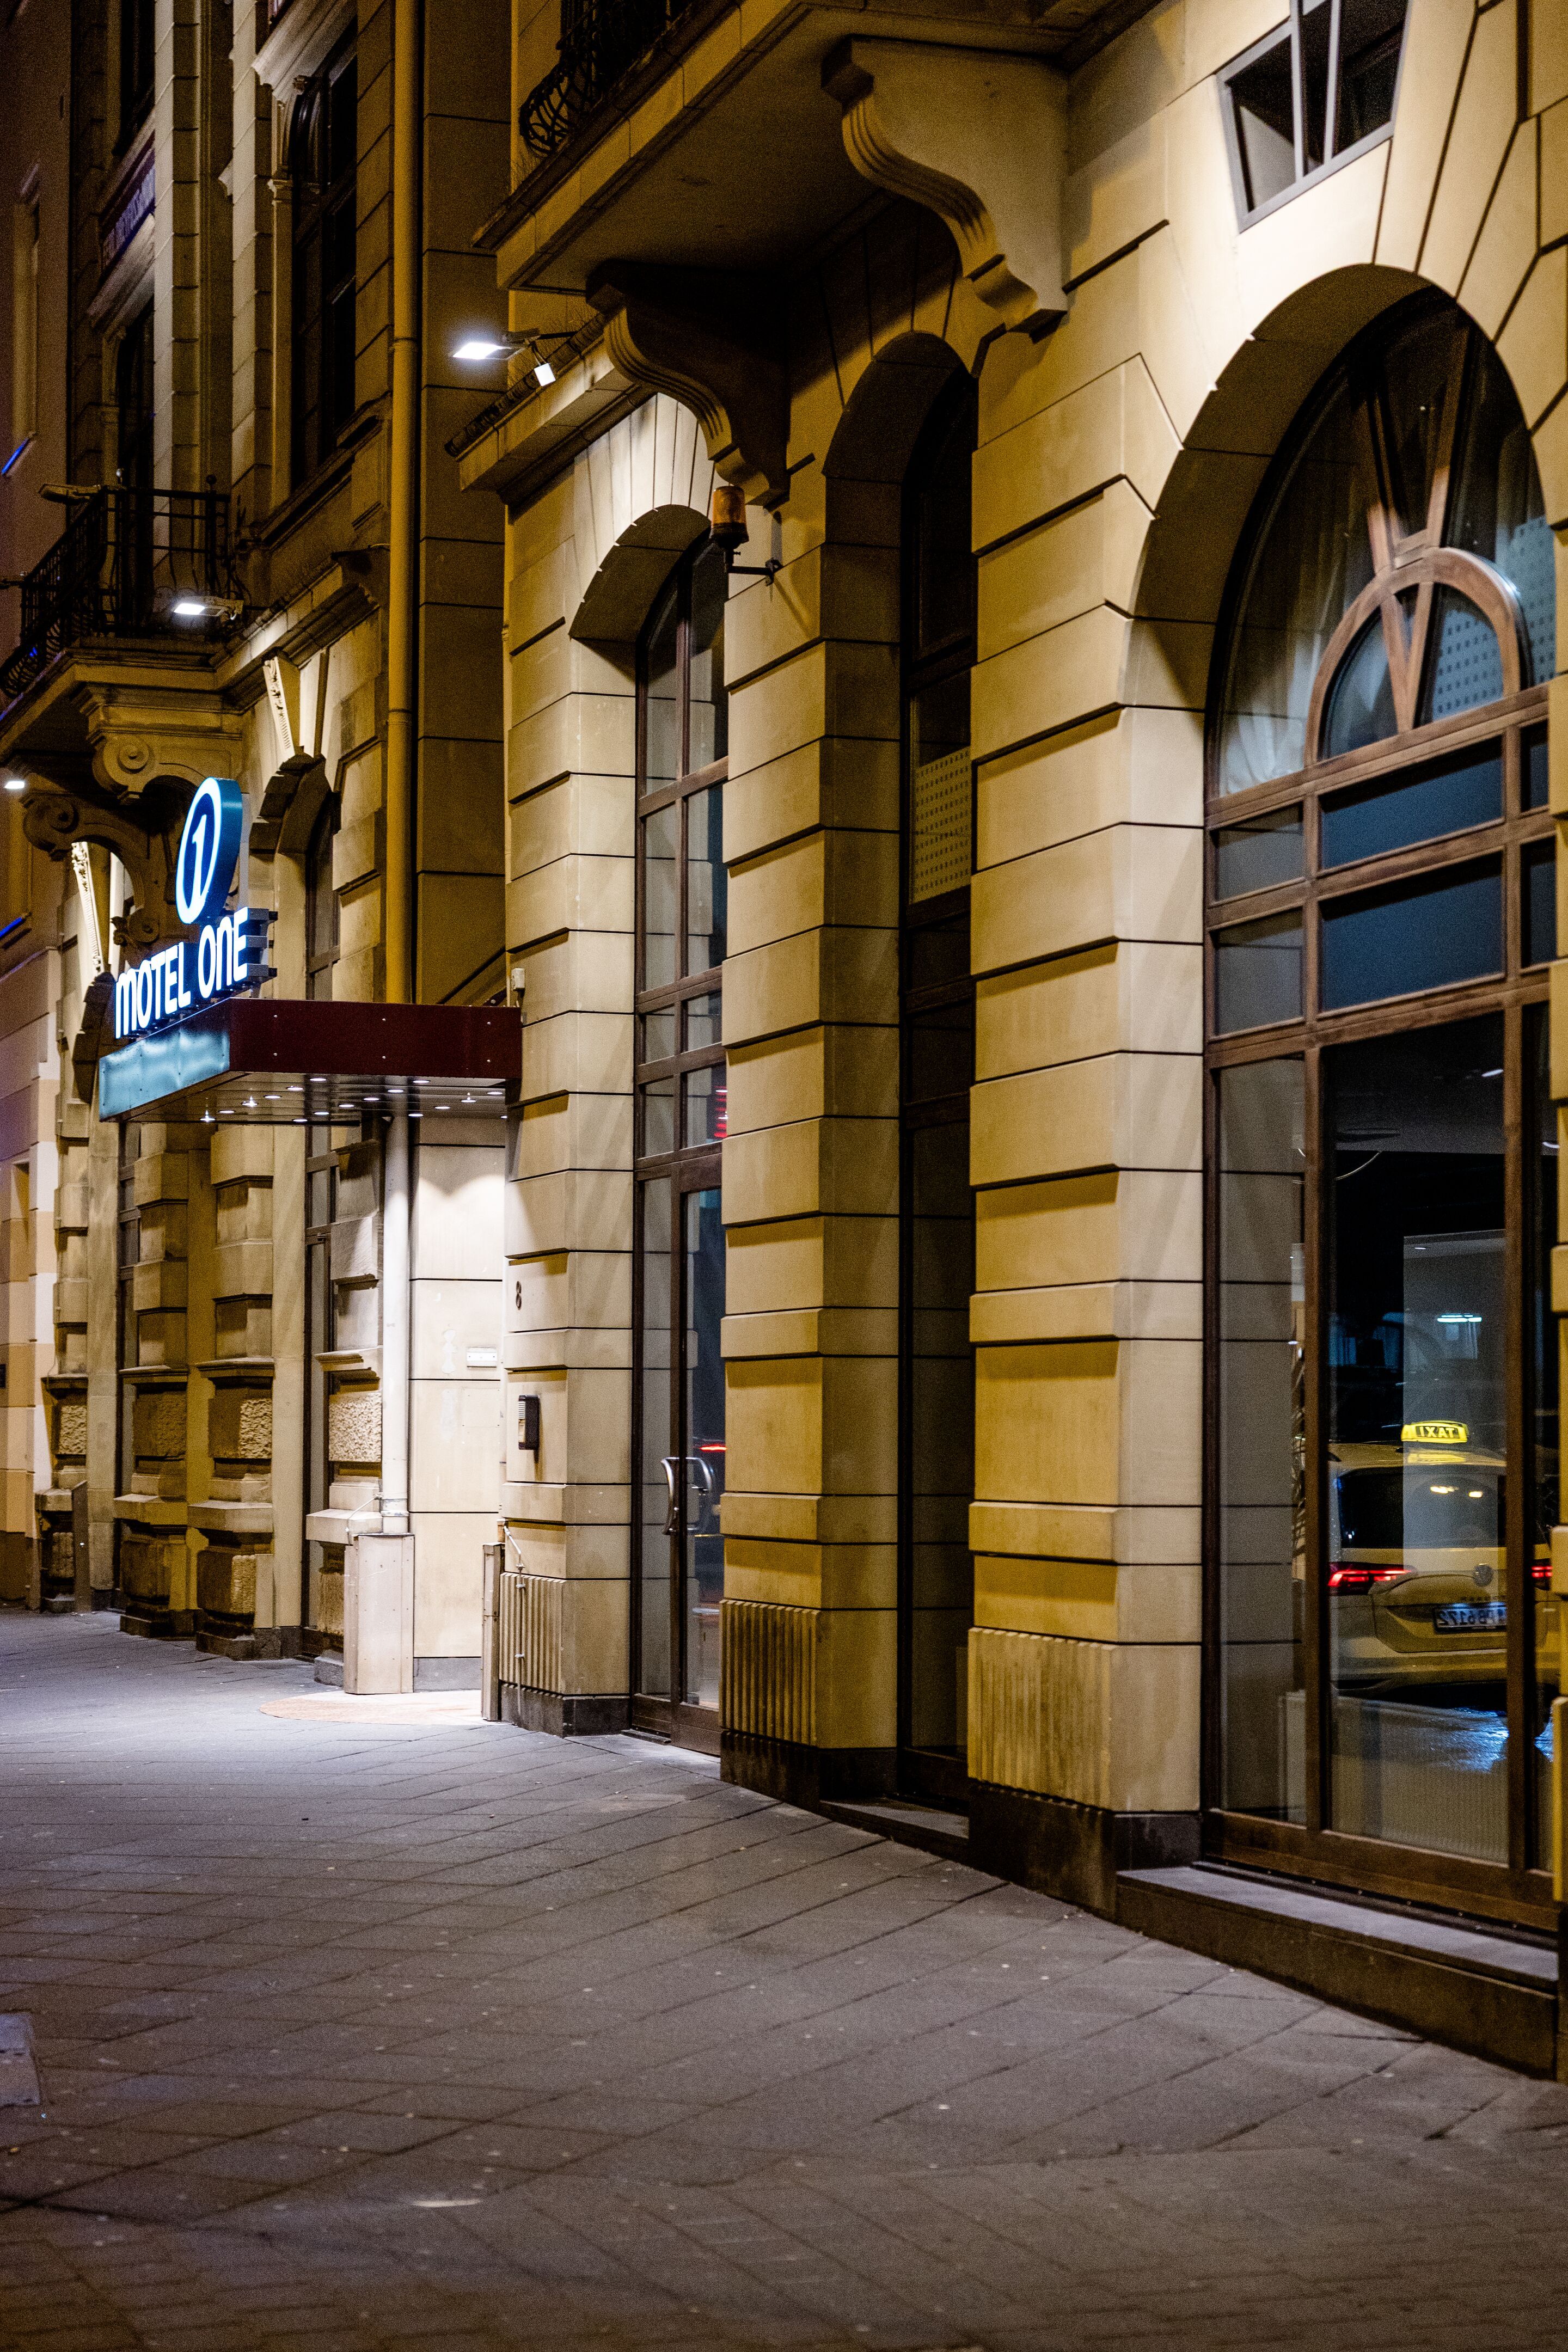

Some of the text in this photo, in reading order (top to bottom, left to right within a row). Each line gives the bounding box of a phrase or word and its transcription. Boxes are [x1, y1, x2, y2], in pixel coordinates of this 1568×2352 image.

[115, 906, 248, 1039] MOTEL ONE
[516, 1281, 522, 1310] 8
